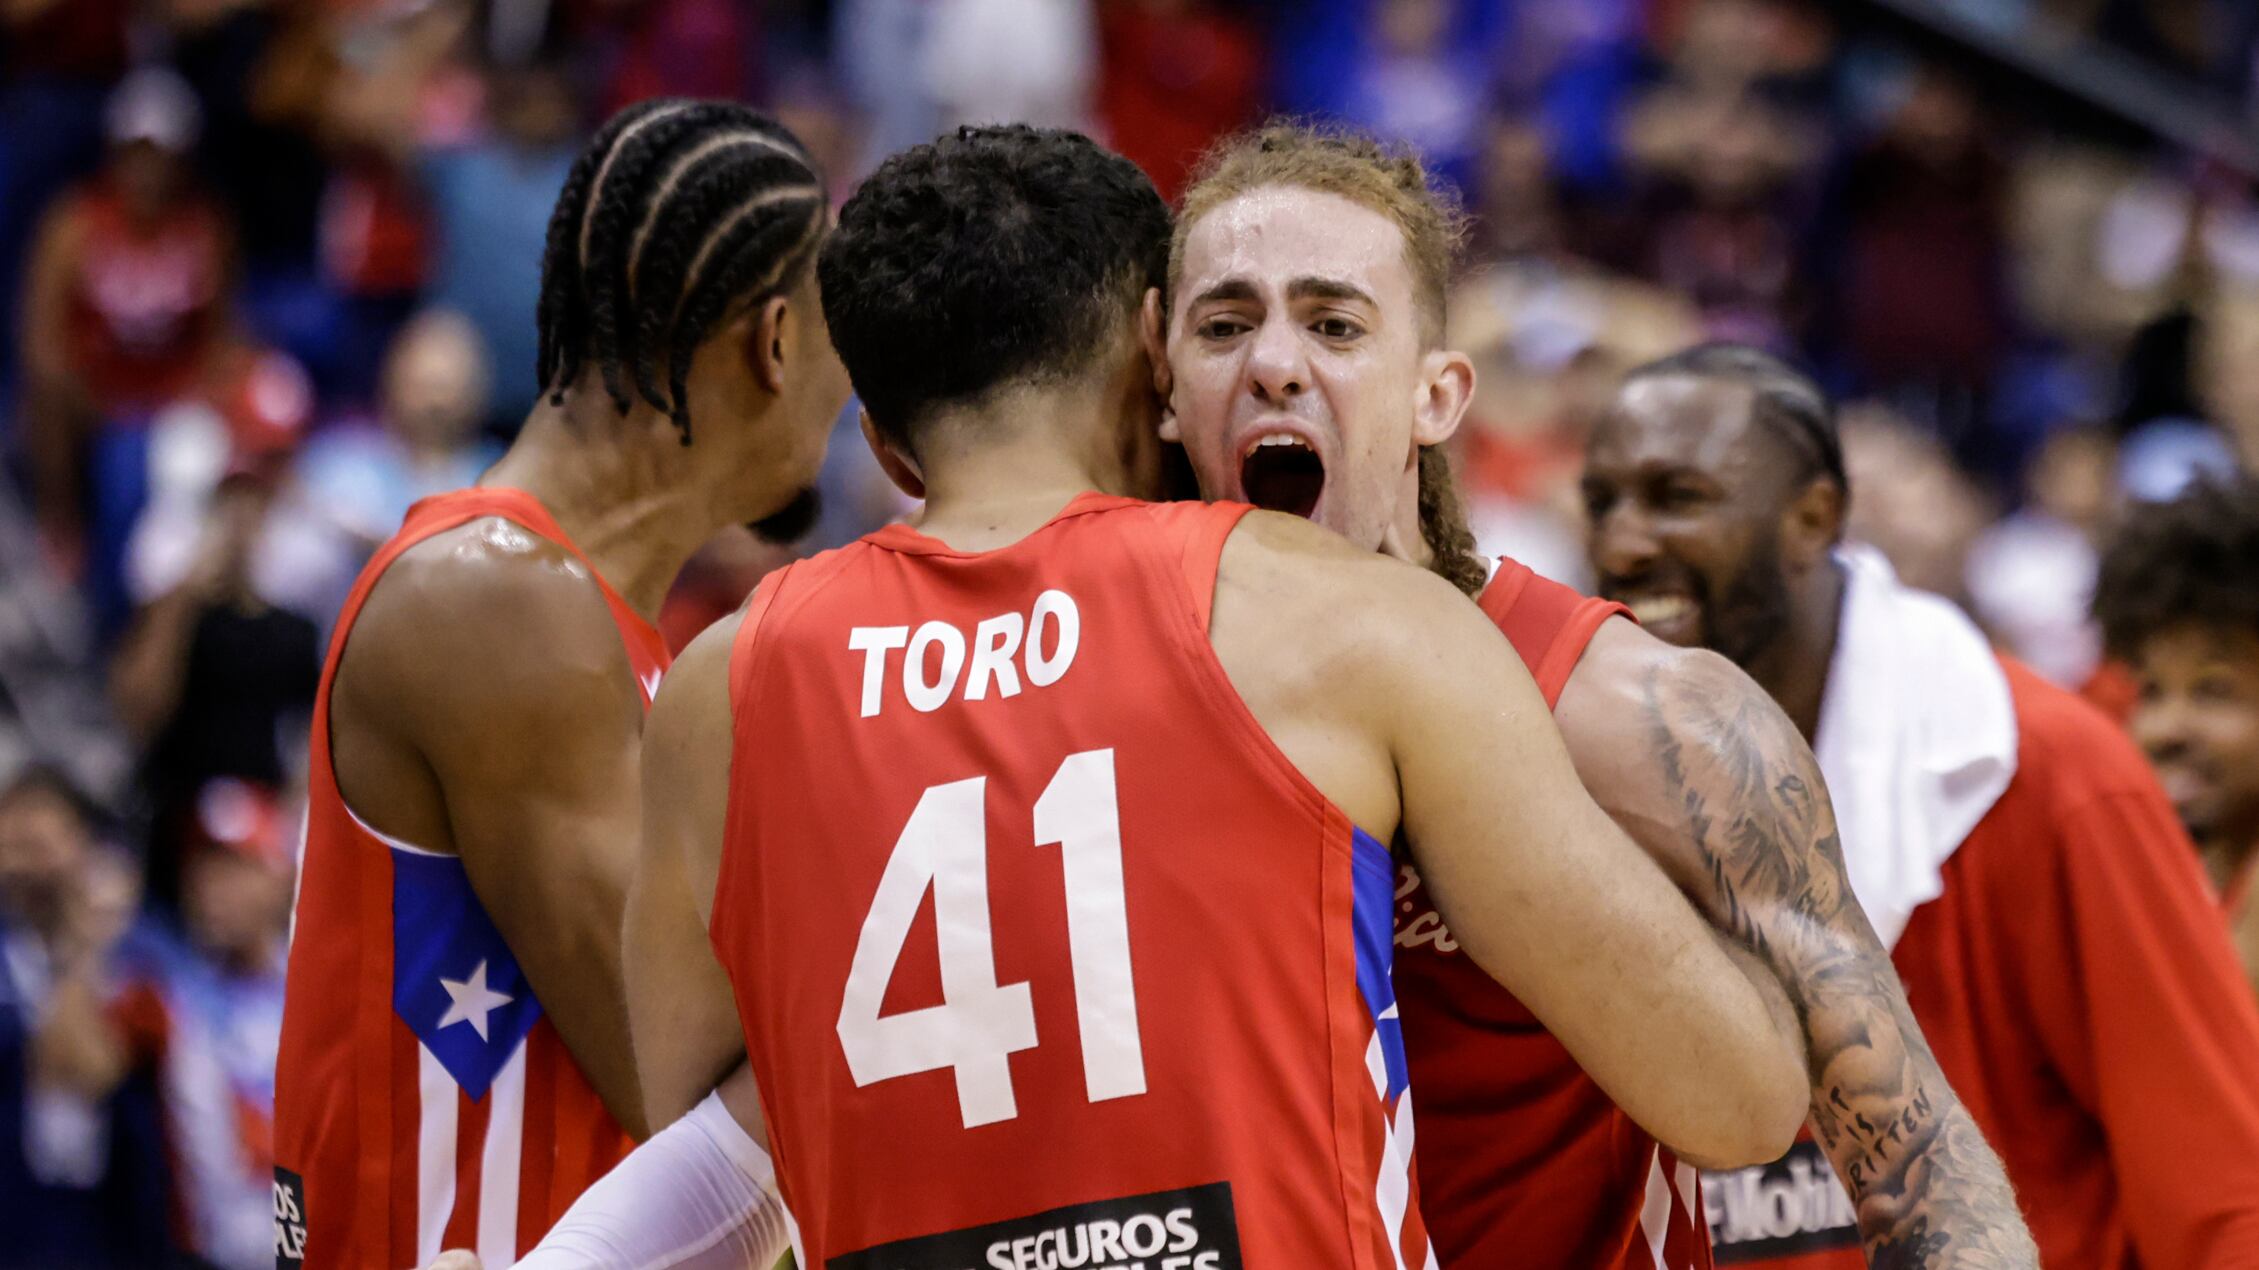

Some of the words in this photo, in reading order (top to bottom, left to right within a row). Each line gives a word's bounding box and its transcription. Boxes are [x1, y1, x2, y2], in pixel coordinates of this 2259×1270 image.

[848, 589, 1080, 718] TORO
[837, 747, 1147, 1130] 41
[1846, 1111, 1875, 1142] IS
[986, 1208, 1199, 1270] SEGUROS
